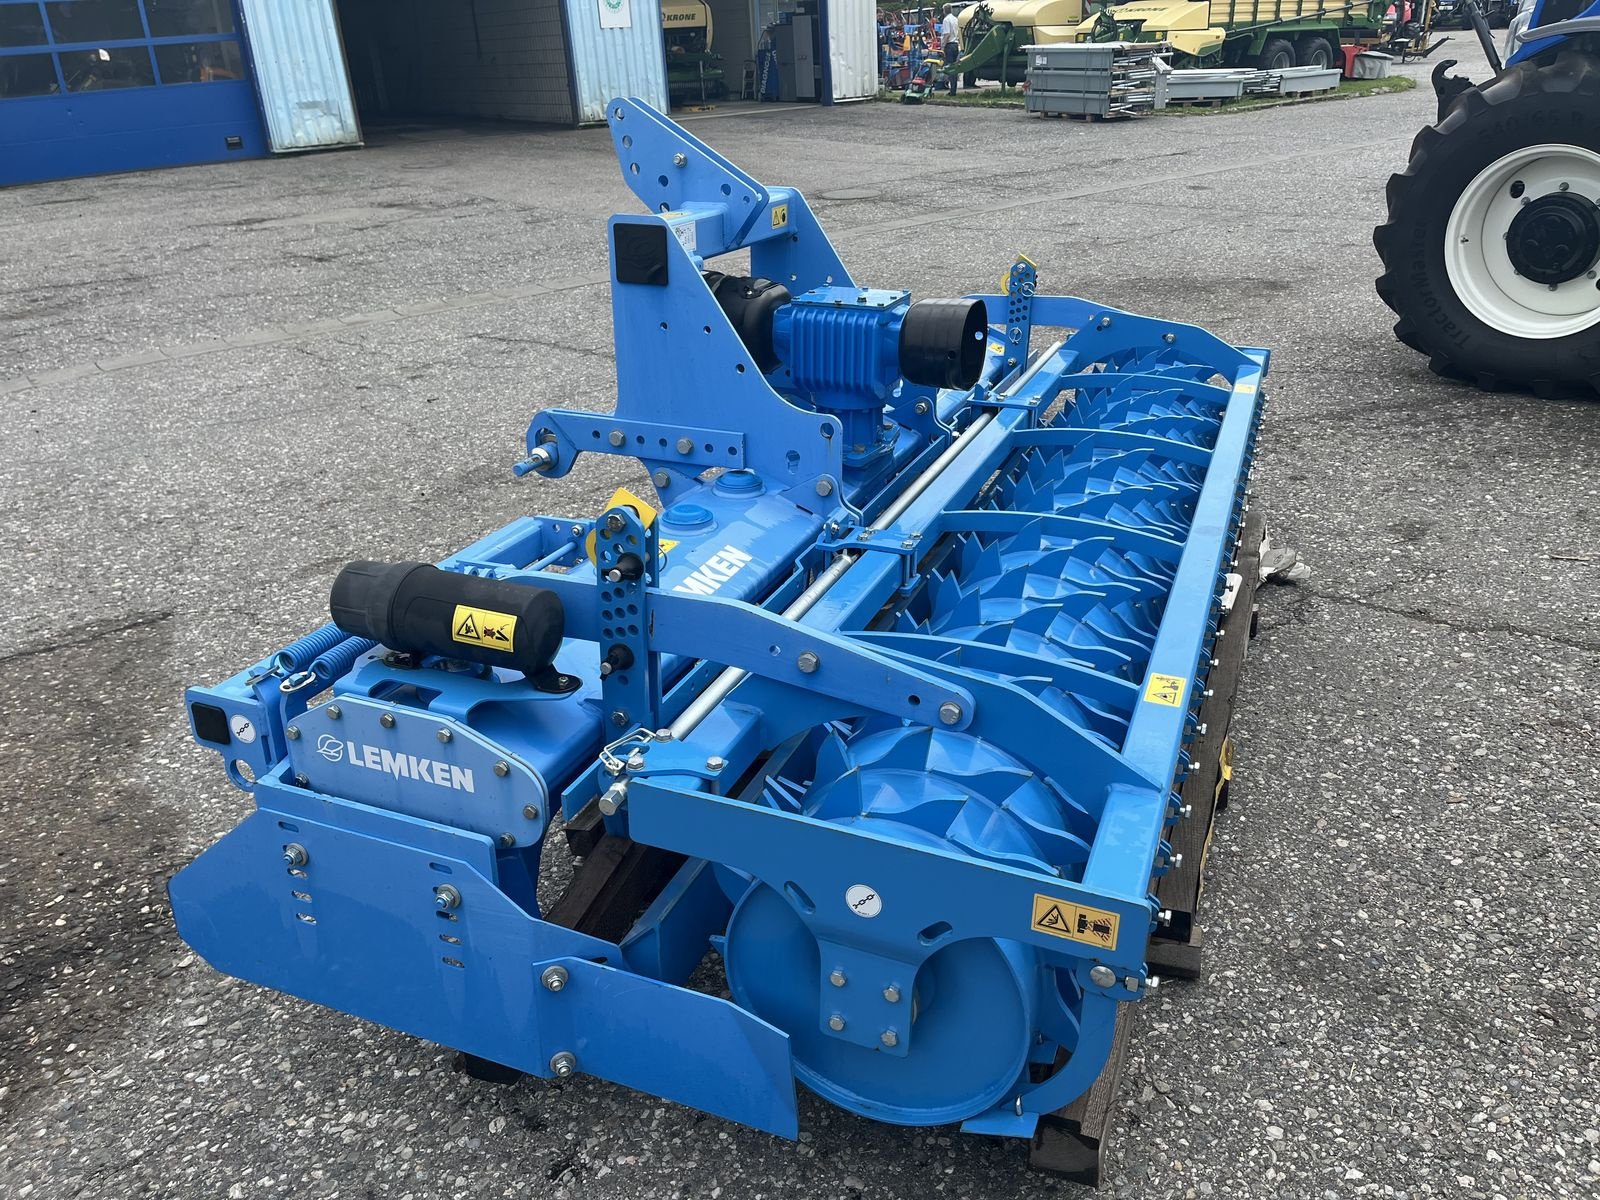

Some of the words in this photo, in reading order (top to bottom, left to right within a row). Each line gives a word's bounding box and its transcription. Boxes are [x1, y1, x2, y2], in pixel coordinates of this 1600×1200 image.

[667, 13, 696, 21] KRONE
[1409, 220, 1471, 350] TractorMaster
[671, 544, 753, 596] MKEN
[347, 741, 475, 793] LEMKEN
